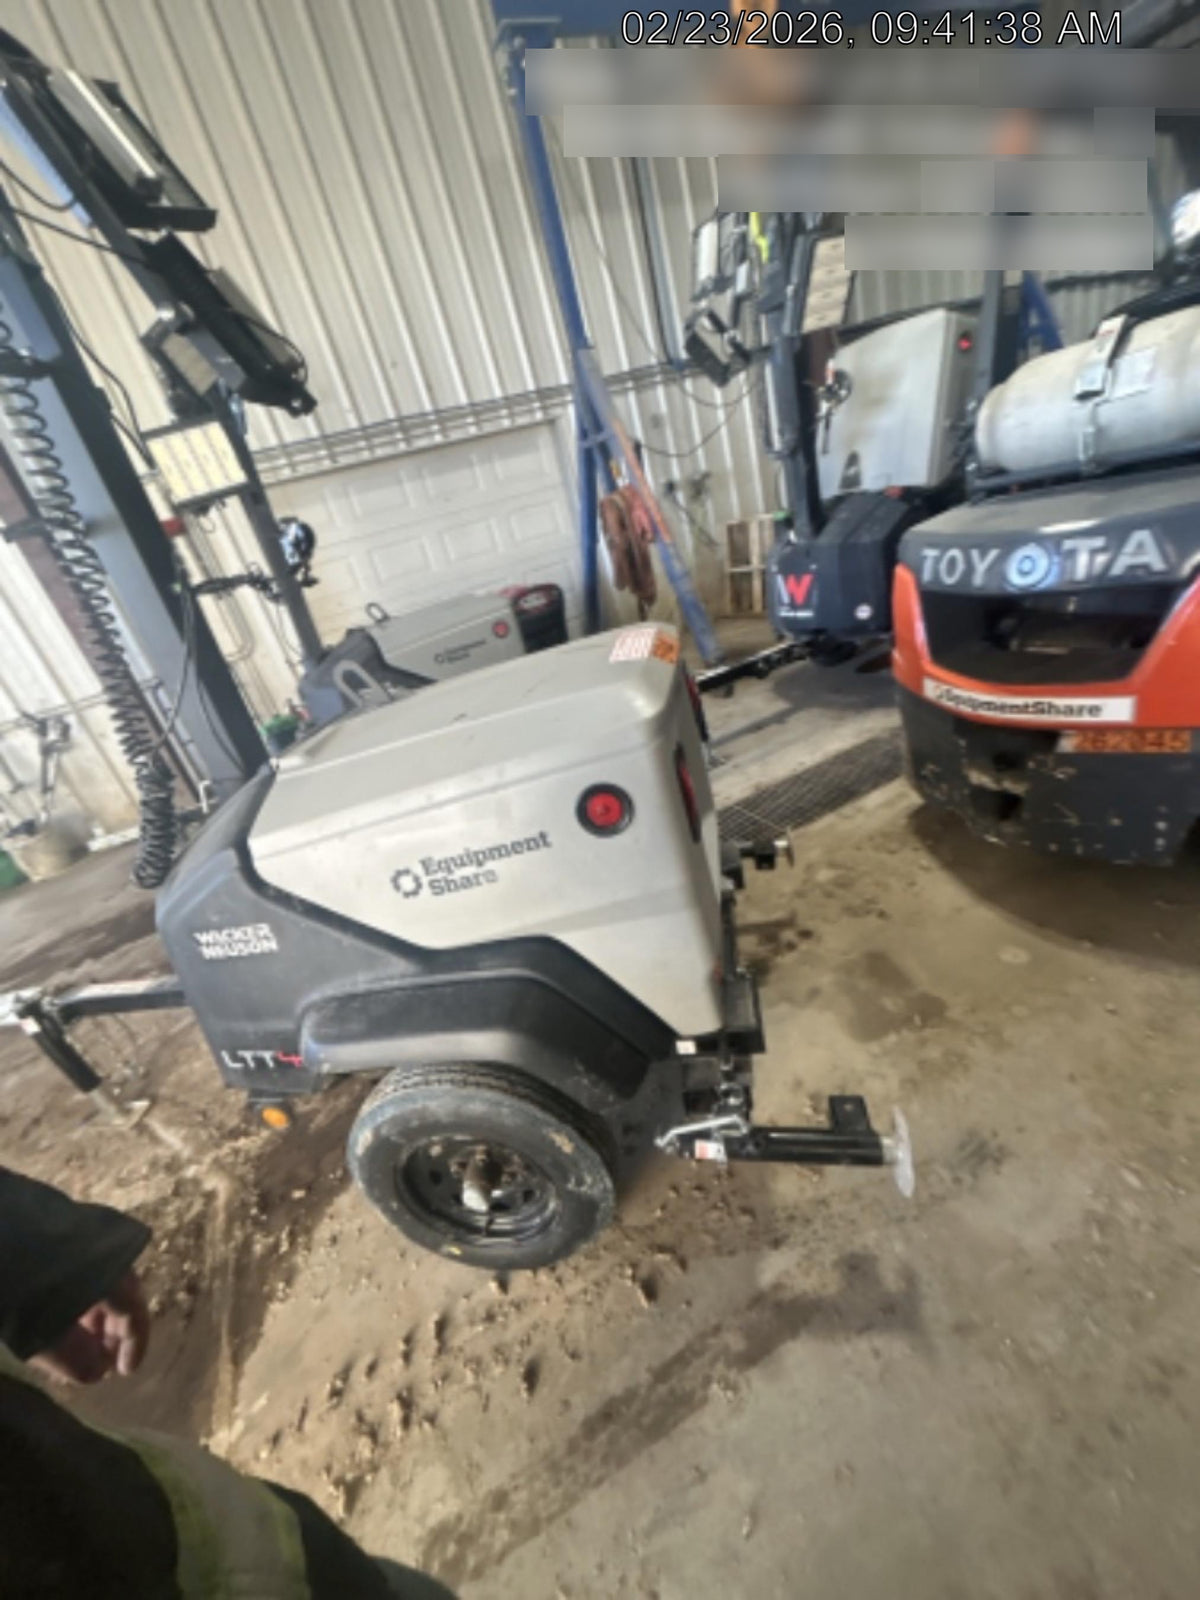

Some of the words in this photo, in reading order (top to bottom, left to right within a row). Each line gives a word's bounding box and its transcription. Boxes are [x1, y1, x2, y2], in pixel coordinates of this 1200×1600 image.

[920, 529, 1166, 588] TOYOTA
[419, 830, 552, 877] Equipment
[428, 868, 498, 897] Share
[221, 1050, 303, 1068] LTT4
